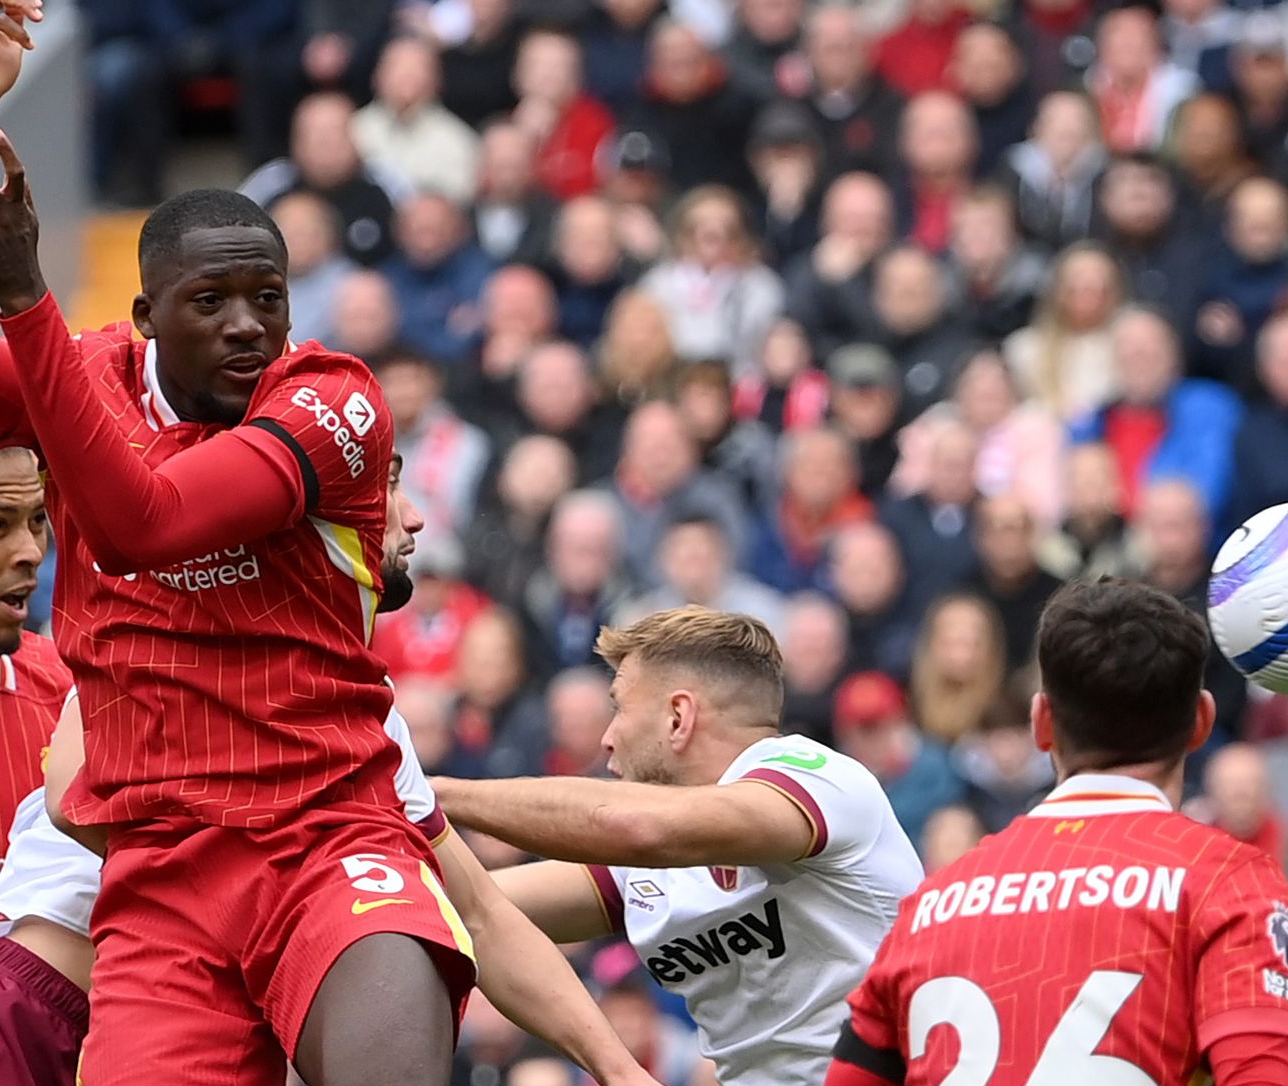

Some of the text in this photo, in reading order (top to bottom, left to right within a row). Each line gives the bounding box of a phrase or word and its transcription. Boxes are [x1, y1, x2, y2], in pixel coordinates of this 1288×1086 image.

[291, 386, 366, 479] Expedia
[340, 852, 405, 894] 5
[909, 864, 1187, 935] ROBERTSON
[646, 898, 786, 987] etway
